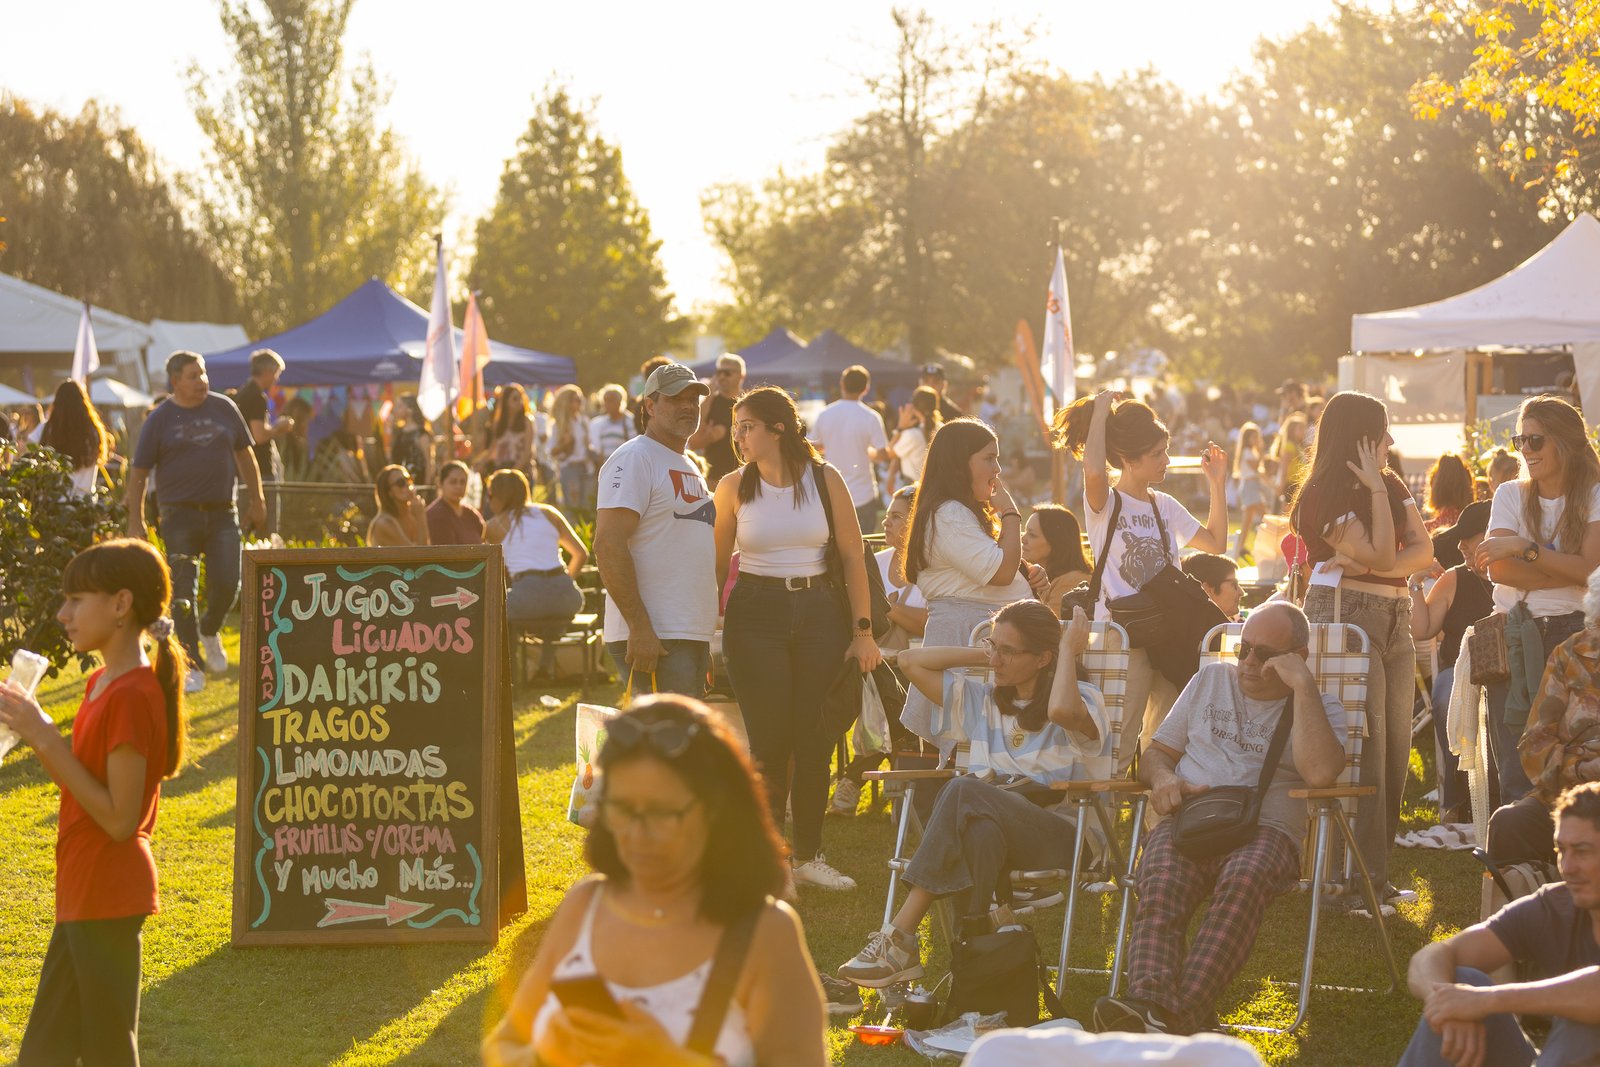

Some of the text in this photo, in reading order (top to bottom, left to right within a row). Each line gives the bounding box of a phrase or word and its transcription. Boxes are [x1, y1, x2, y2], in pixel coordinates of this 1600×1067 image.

[612, 465, 624, 489] AIR
[681, 473, 709, 498] NIK
[291, 572, 416, 622] JUGOS
[259, 573, 275, 700] HOLI BAR
[262, 704, 391, 746] TRAGOS
[1210, 726, 1265, 753] DREAING
[264, 778, 475, 822] CHOCOTORTAS
[273, 858, 294, 893] Y
